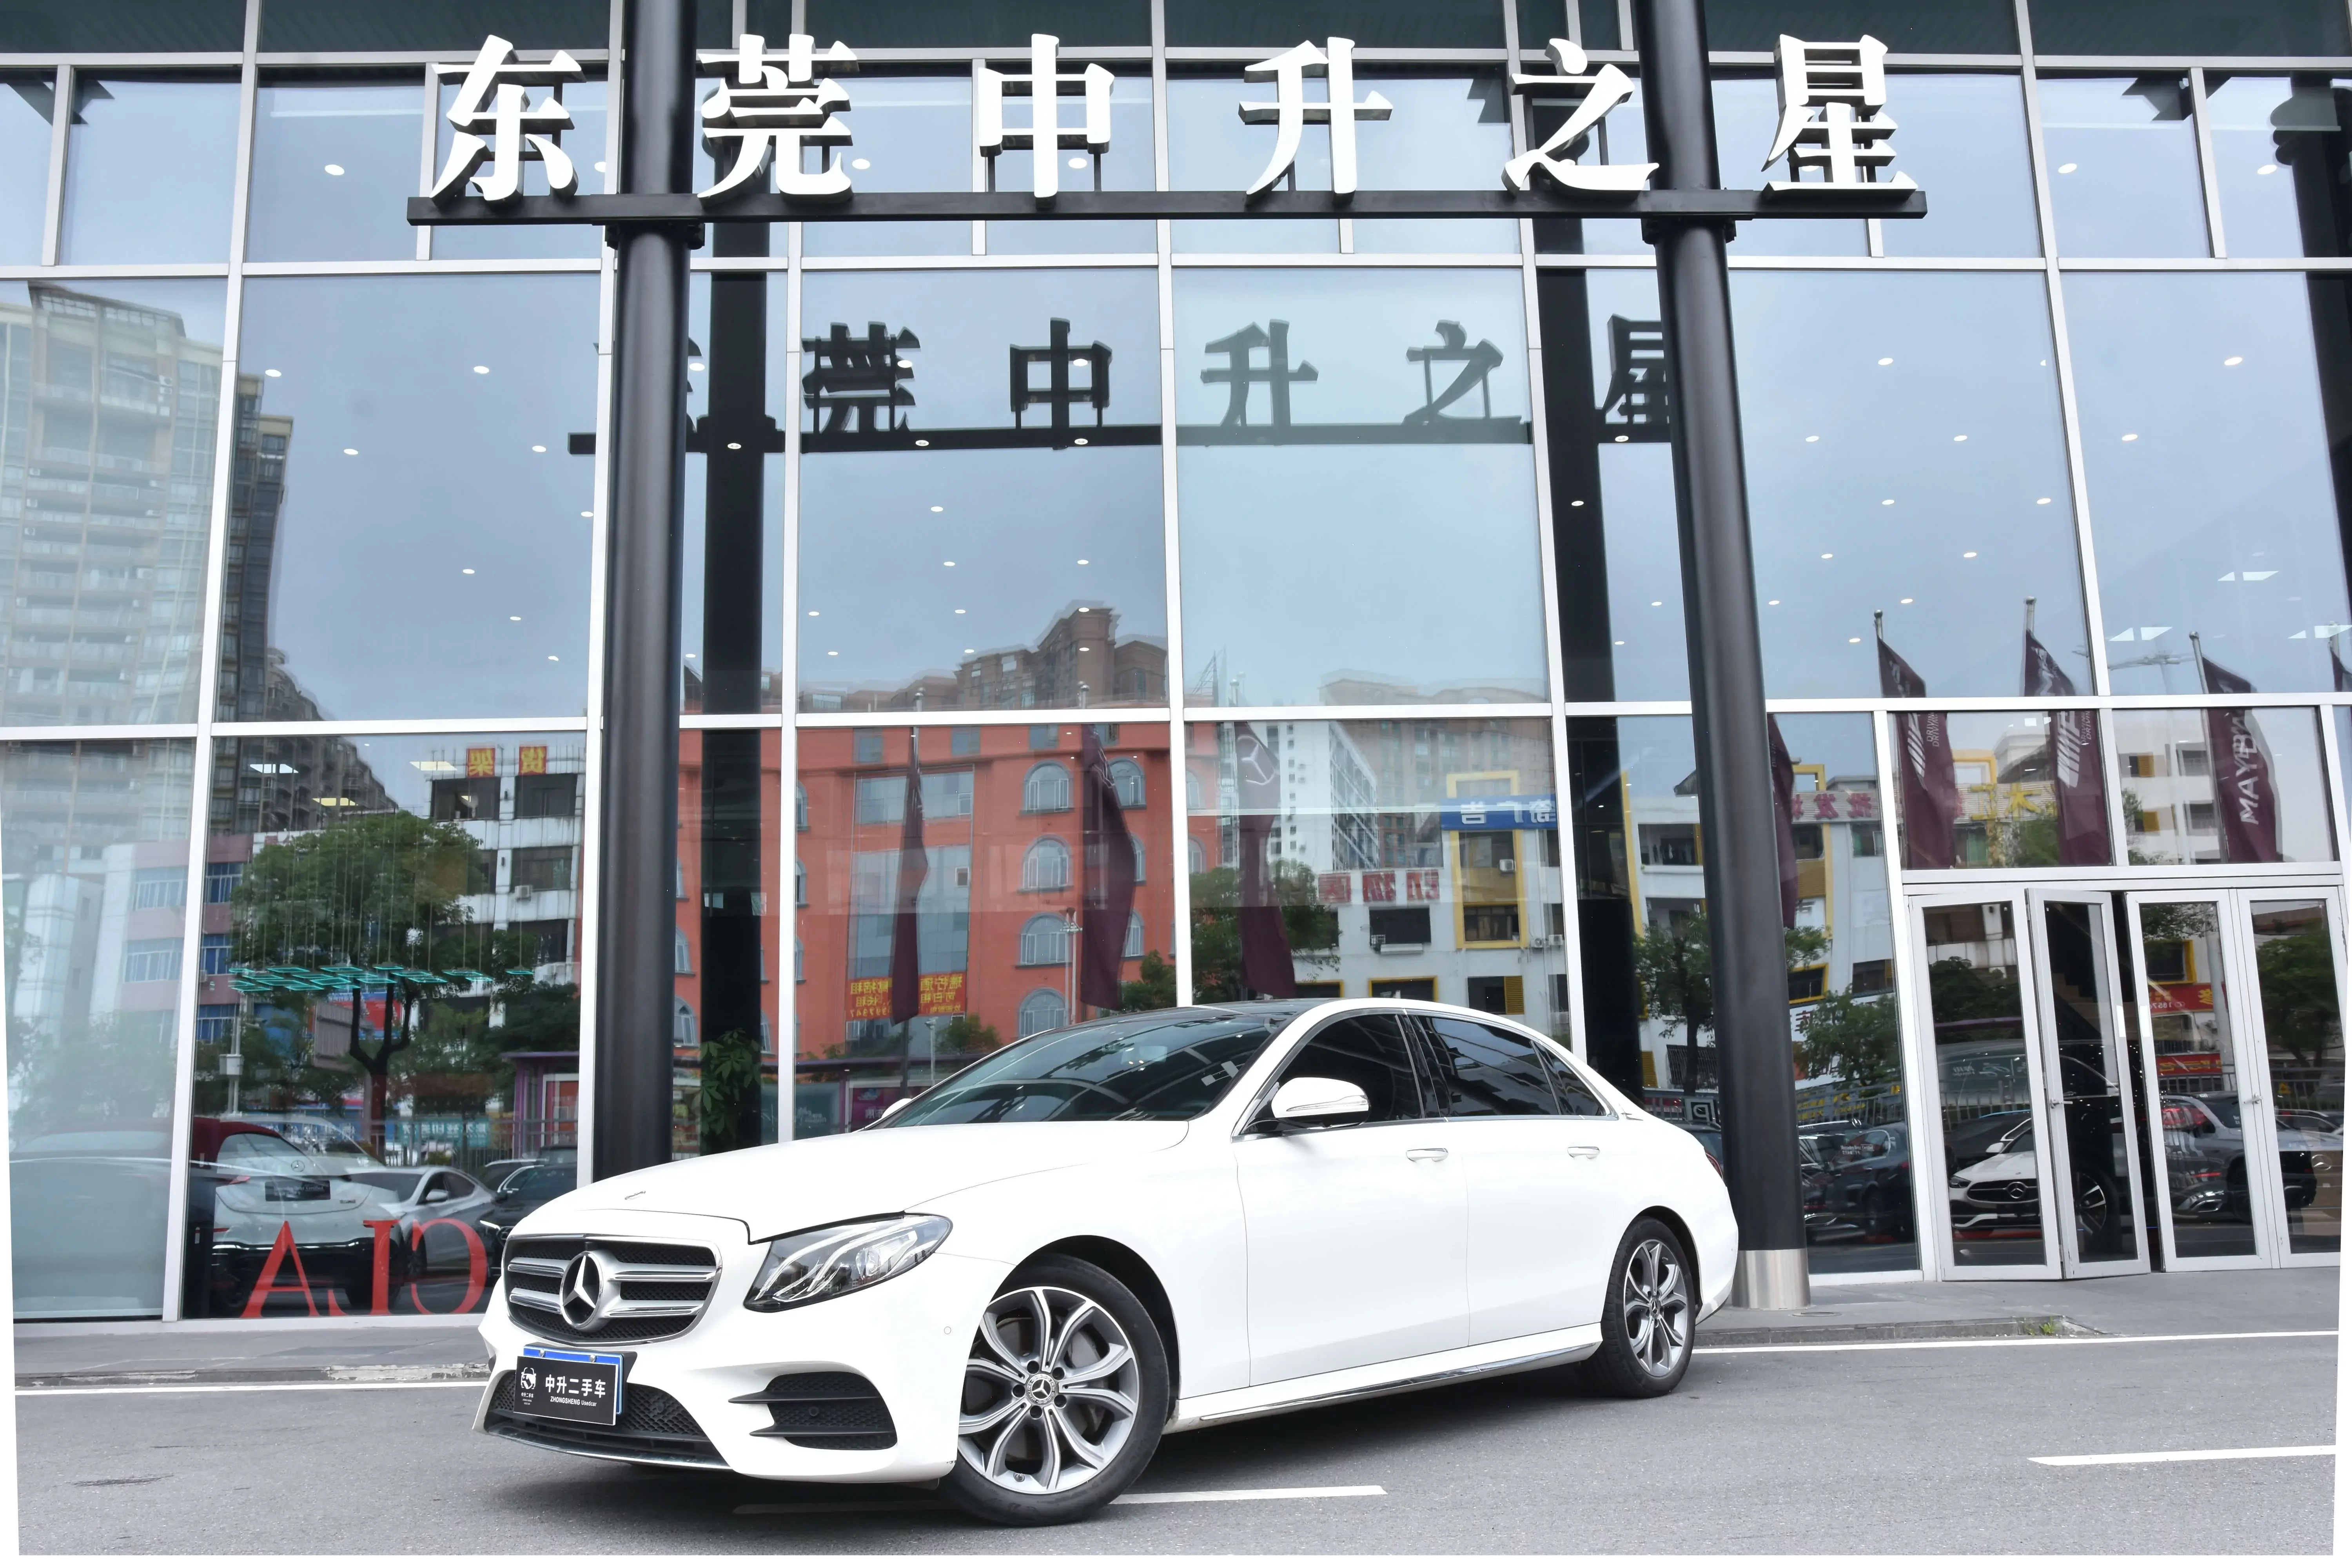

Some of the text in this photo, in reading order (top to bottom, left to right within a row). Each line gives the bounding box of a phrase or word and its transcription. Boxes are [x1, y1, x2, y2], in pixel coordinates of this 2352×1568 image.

[430, 34, 1919, 202] 东莞中升之星
[545, 1374, 606, 1398] 中升二手车
[550, 1396, 581, 1405] ZHONGSHENG
